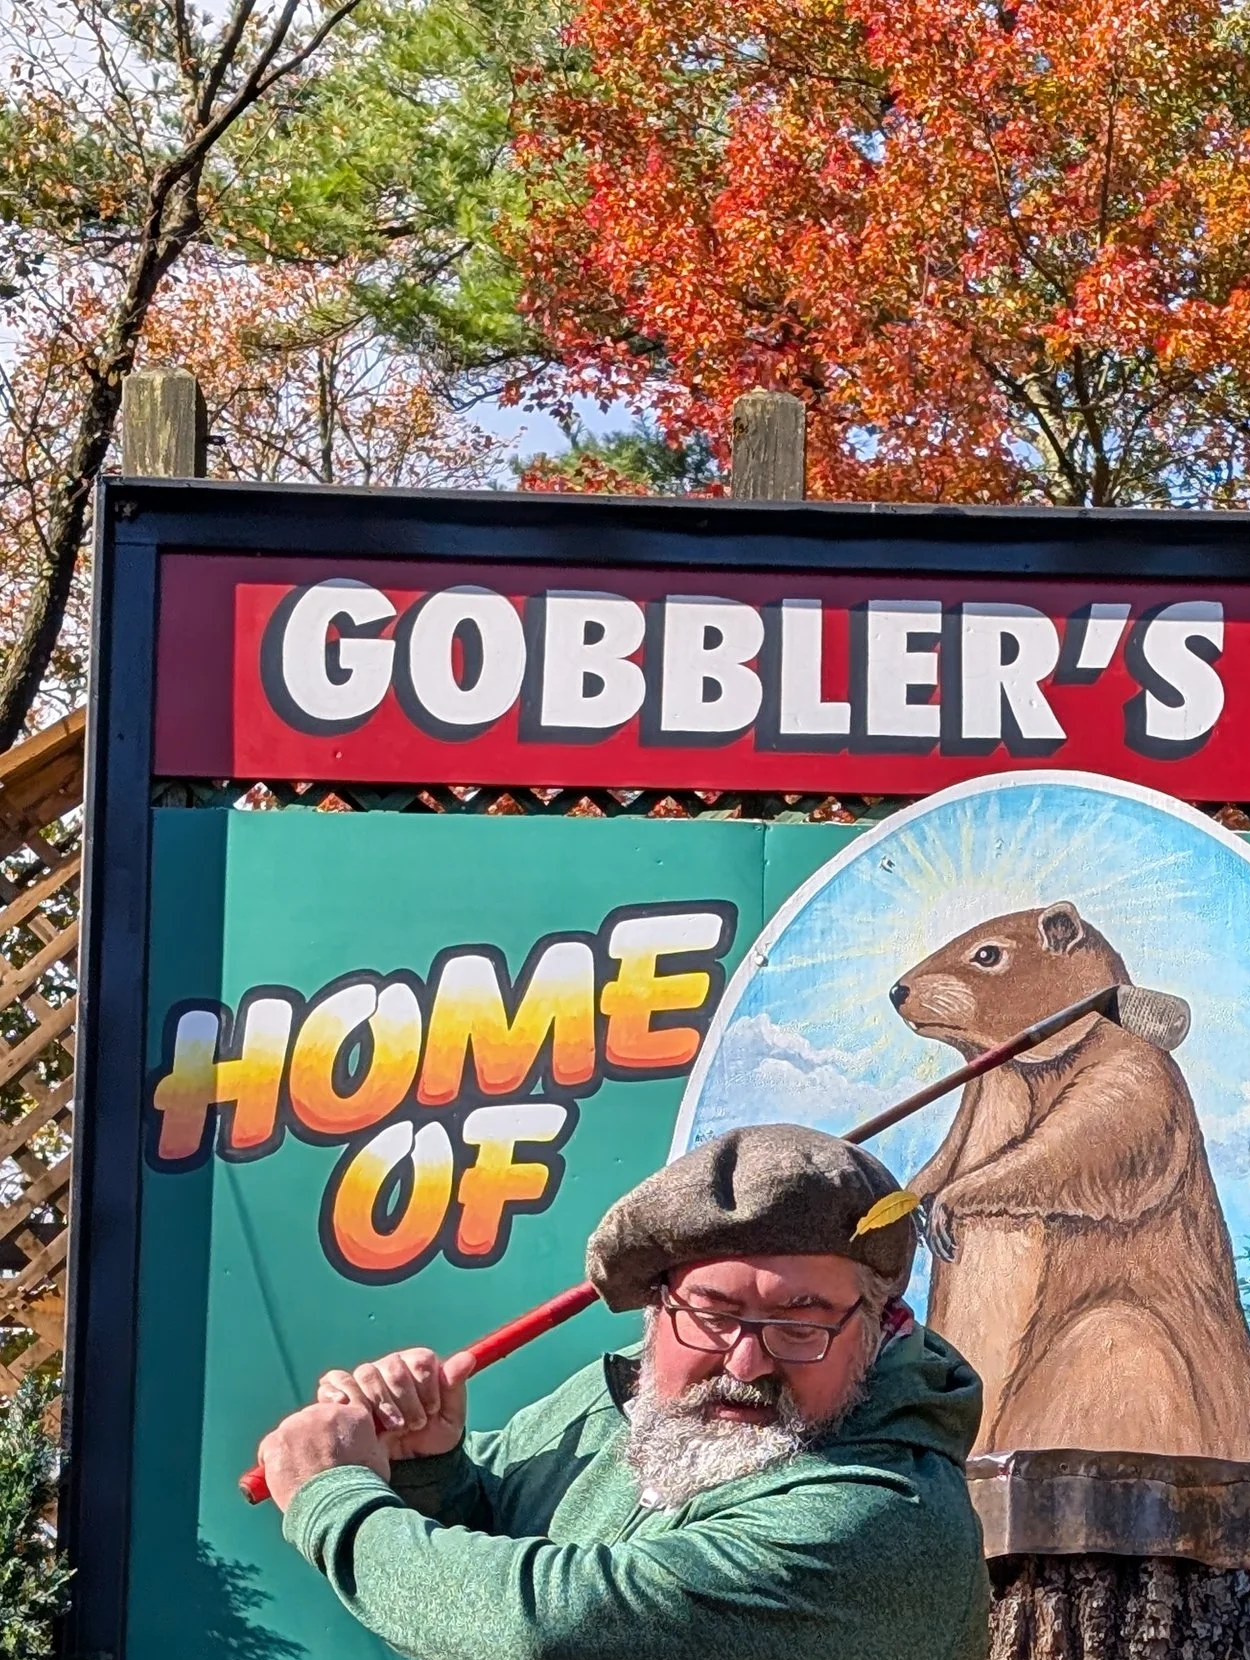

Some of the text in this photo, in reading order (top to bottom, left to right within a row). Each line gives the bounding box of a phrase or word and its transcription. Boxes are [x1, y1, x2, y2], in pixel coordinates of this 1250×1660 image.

[281, 577, 1224, 742] GOBBLER'S
[152, 910, 728, 1162] HOME
[330, 1102, 564, 1272] OF
